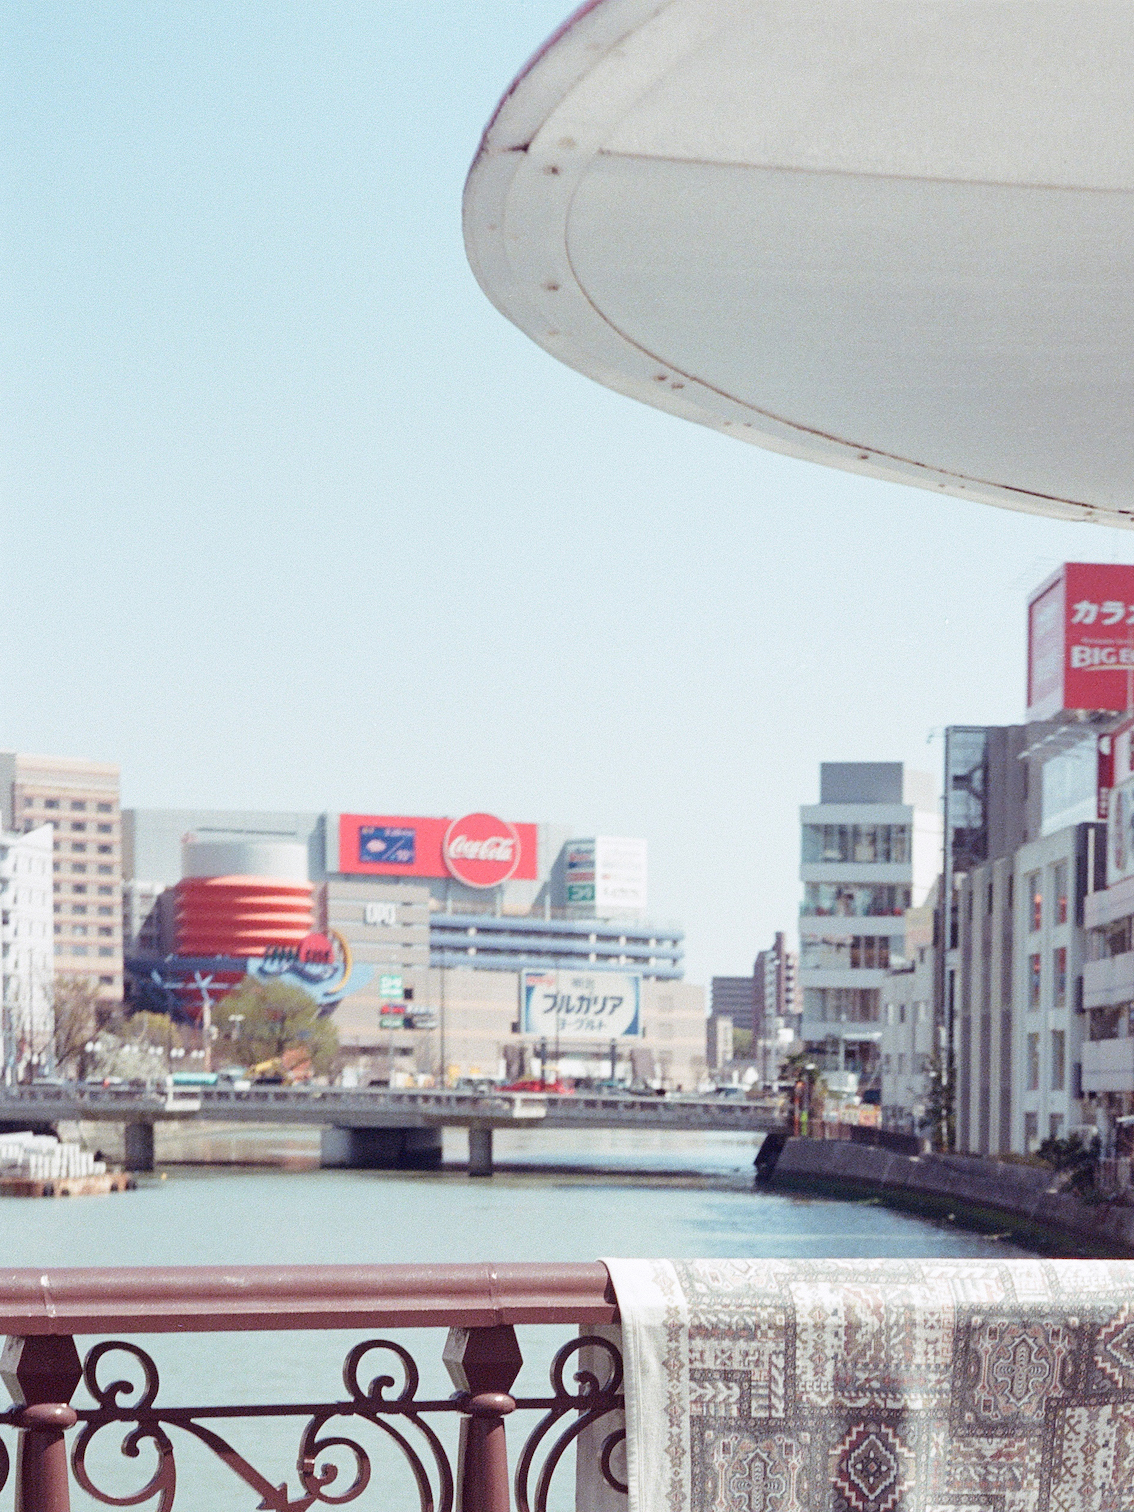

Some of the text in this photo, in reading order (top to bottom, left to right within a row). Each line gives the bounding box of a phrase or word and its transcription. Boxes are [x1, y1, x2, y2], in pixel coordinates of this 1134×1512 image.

[543, 993, 624, 1016] ブルガリア
